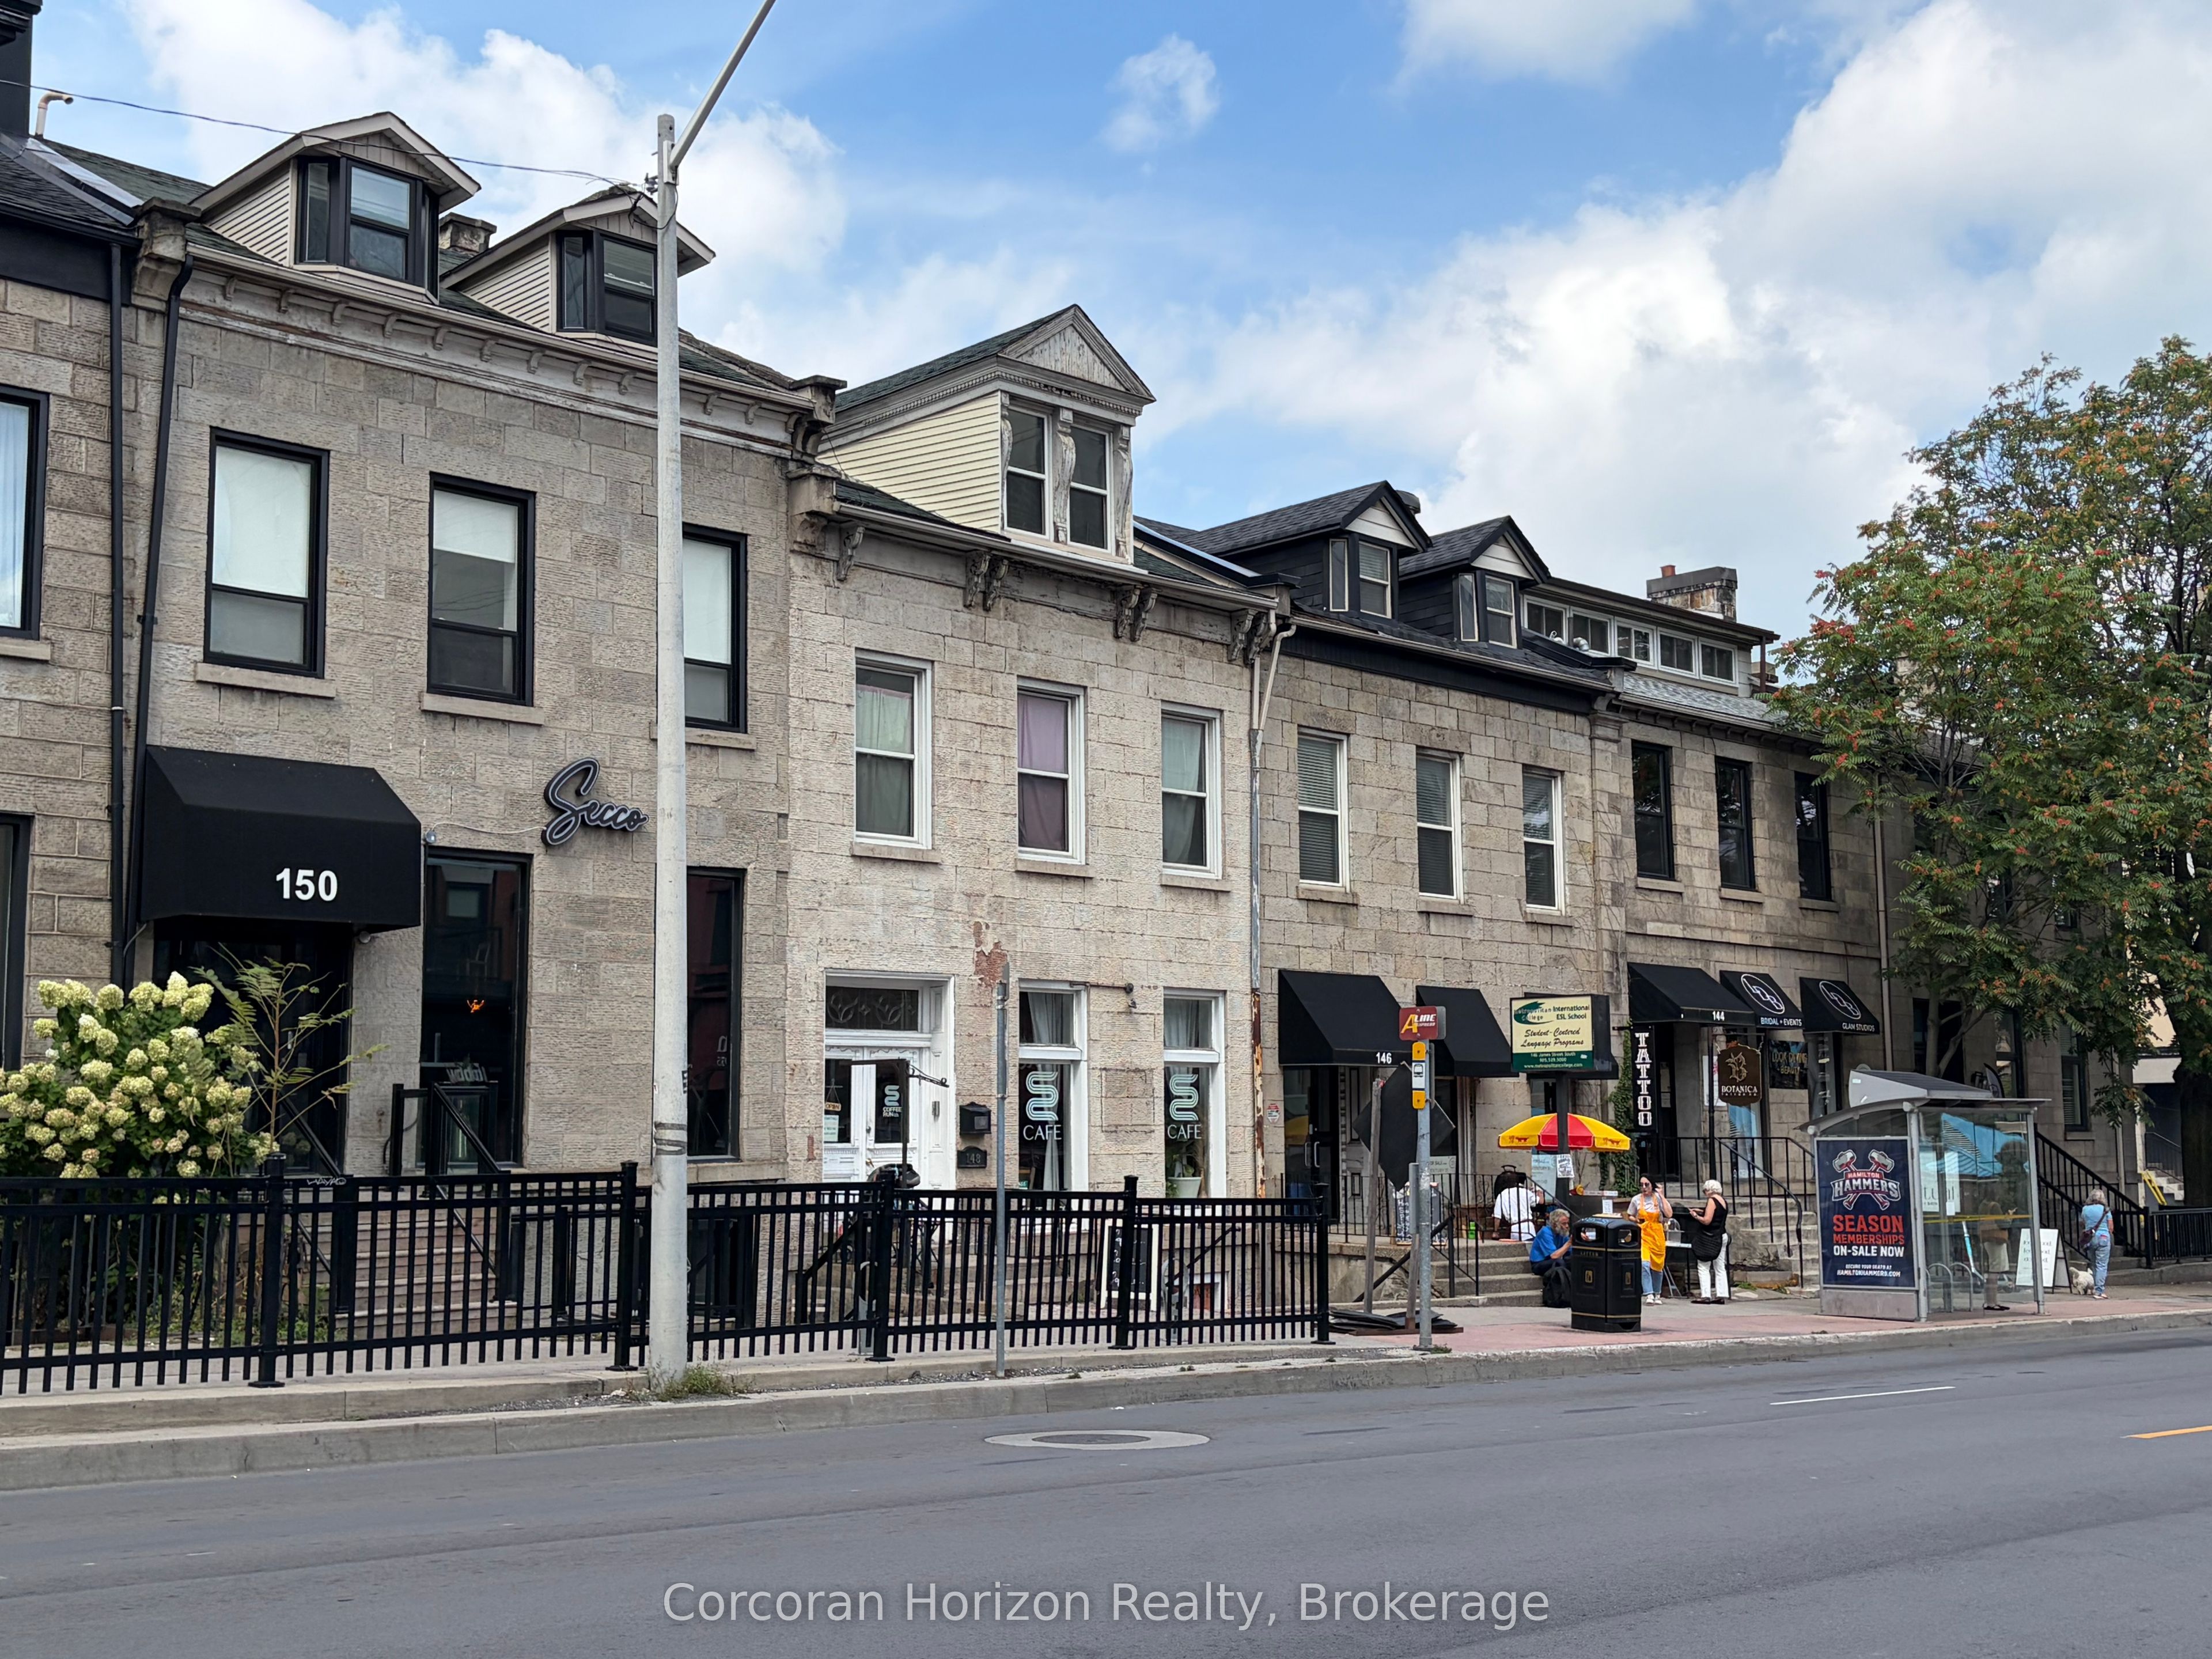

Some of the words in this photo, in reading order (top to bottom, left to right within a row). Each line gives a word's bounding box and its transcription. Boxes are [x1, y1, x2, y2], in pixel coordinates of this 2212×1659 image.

[541, 757, 649, 846] Secco
[276, 868, 338, 902] 150
[1414, 1014, 1437, 1022] LINE
[1713, 1010, 1725, 1021] 144
[1760, 1017, 1779, 1025] BRIDAL
[1400, 1014, 1418, 1033] A
[1856, 1024, 1875, 1032] STUDIOS
[1521, 1039, 1551, 1048] Language
[1553, 1038, 1584, 1048] Programs
[1376, 1052, 1392, 1064] 146
[1634, 1032, 1652, 1126] TATTOO
[1023, 1124, 1062, 1140] CAFE
[1167, 1124, 1202, 1139] CAFE
[966, 1153, 981, 1164] 148
[1835, 1179, 1899, 1198] HAMMERS
[1833, 1215, 1904, 1233] SEASON
[1834, 1234, 1904, 1244] MEMBERSHIPS
[1834, 1245, 1877, 1256] ON-SALE
[1880, 1246, 1904, 1257] NOW
